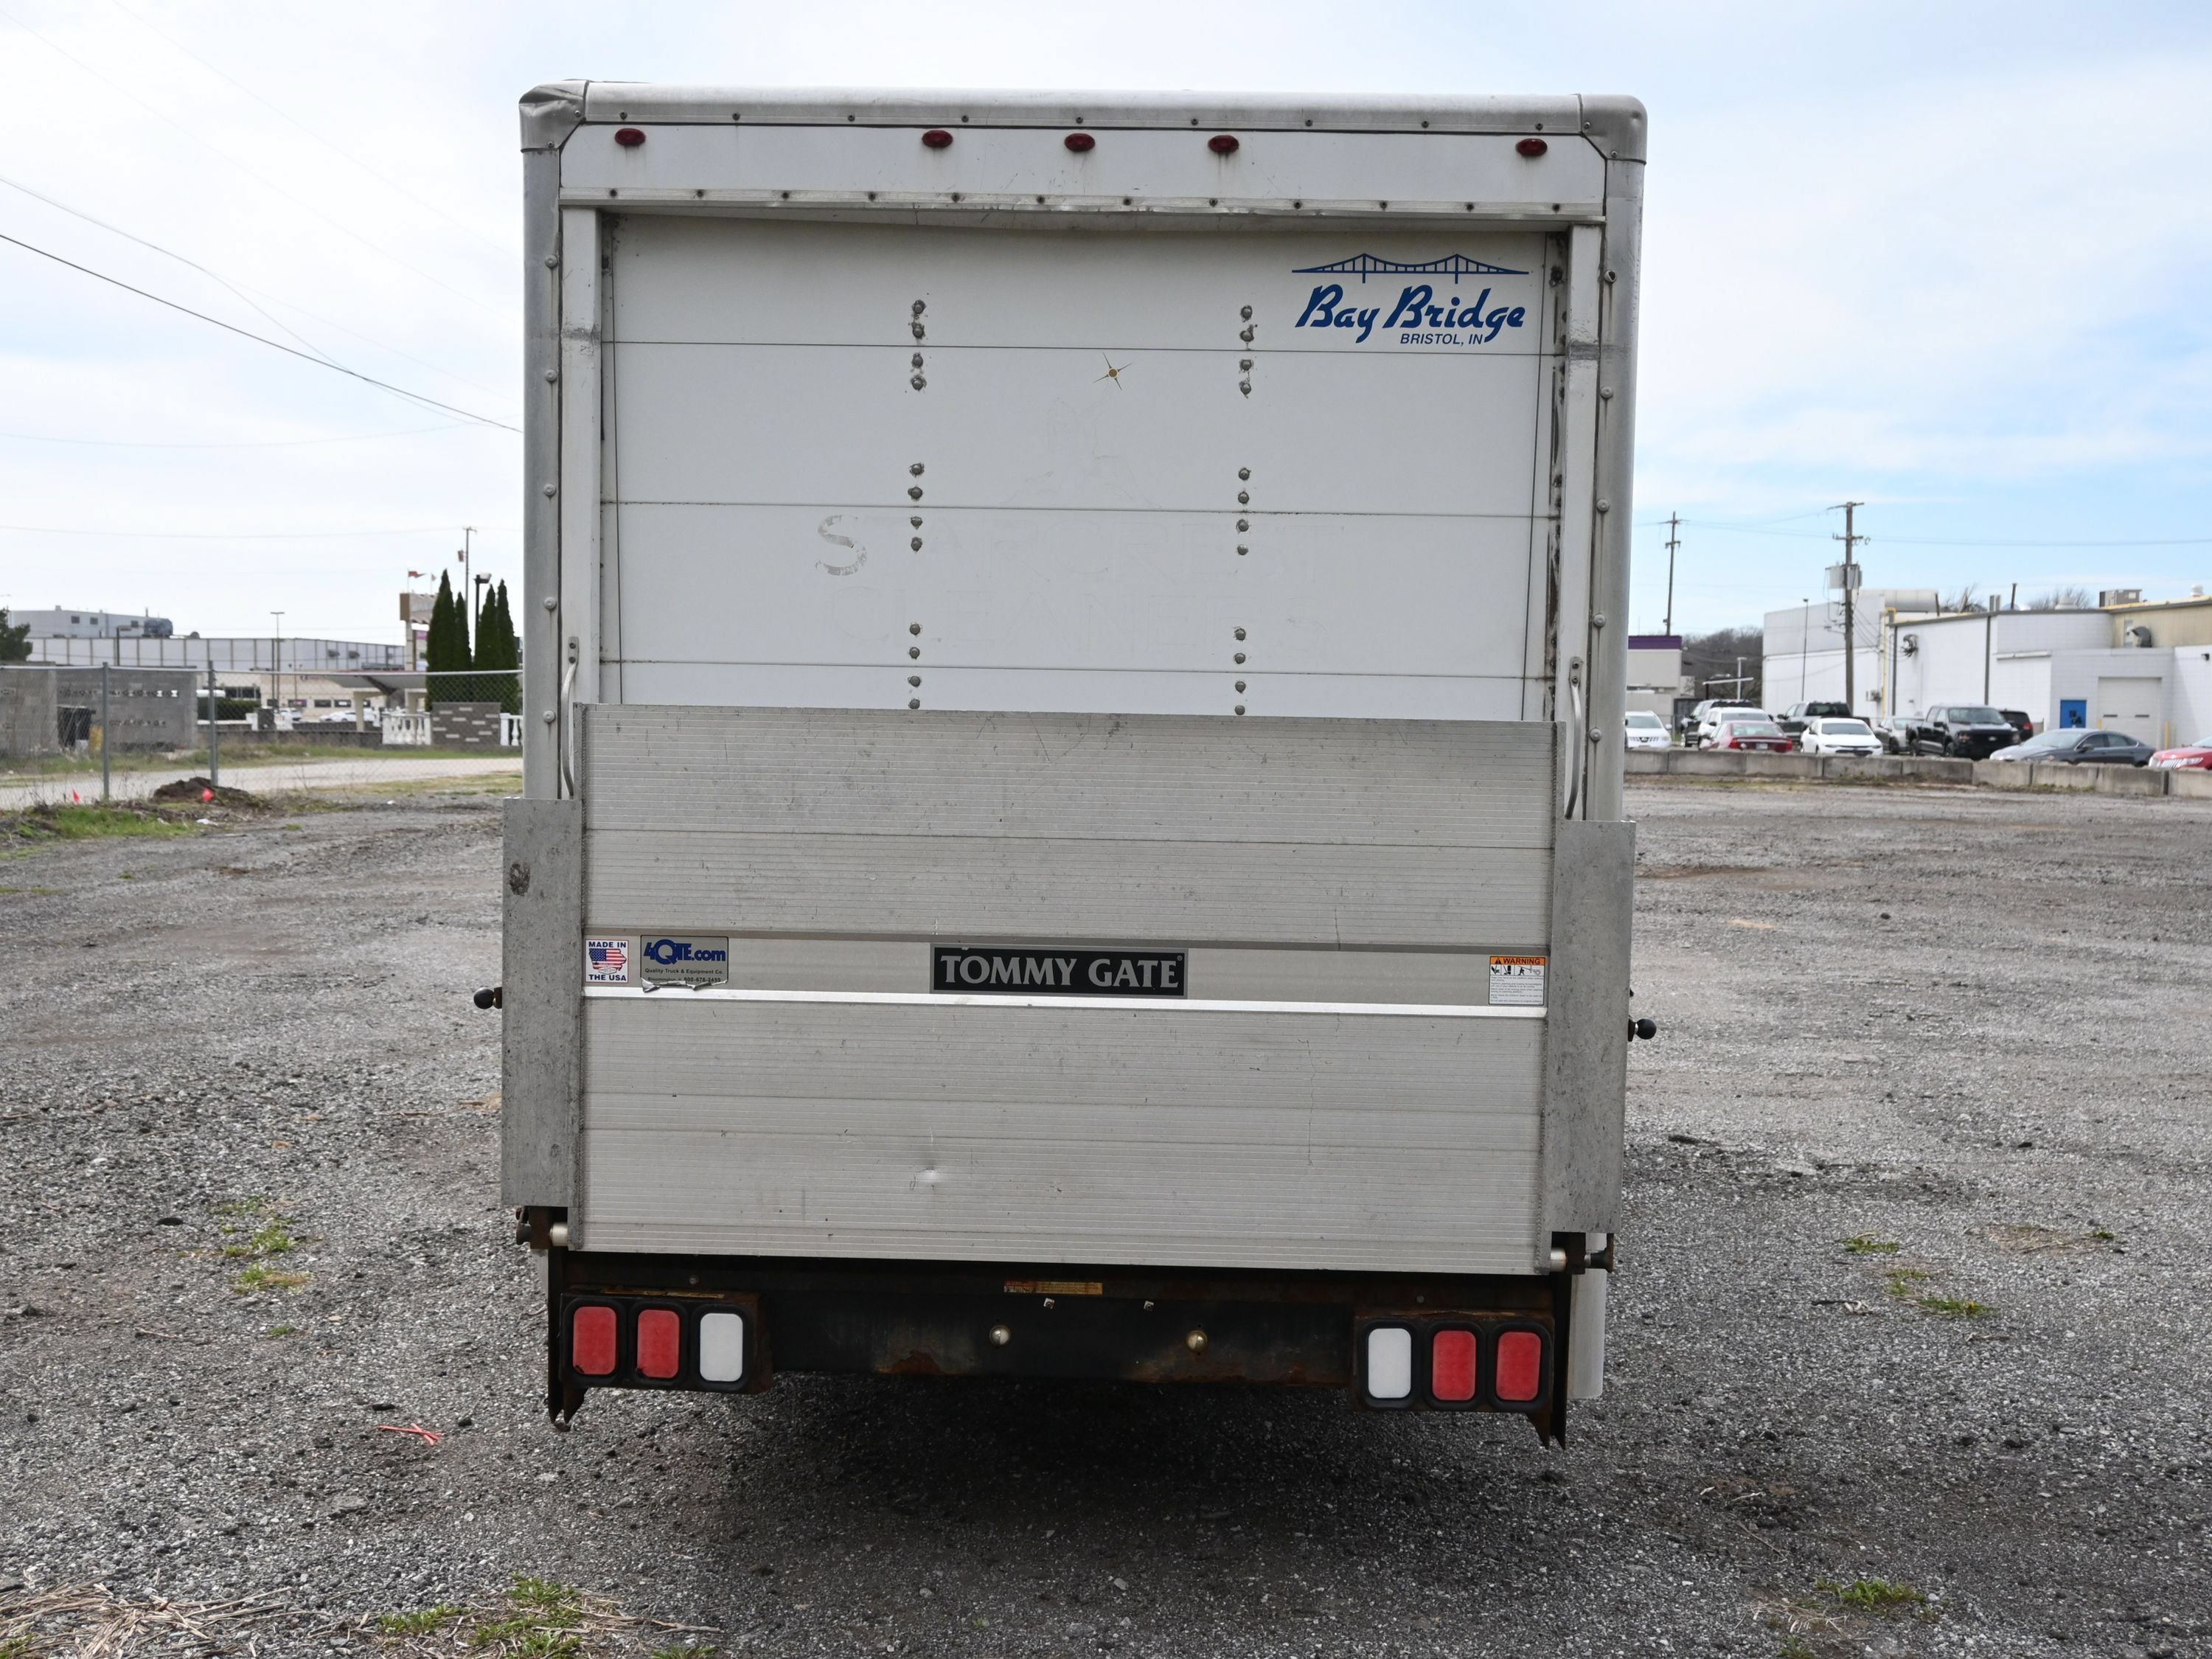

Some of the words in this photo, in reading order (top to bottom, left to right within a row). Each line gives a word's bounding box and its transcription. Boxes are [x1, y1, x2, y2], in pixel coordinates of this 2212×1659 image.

[1295, 284, 1380, 344] Bay
[1382, 285, 1526, 343] Bridge
[1400, 334, 1464, 346] BRISTOL,
[1469, 334, 1483, 344] IN
[940, 956, 1077, 985] TOMMY
[1088, 959, 1179, 987] GATE
